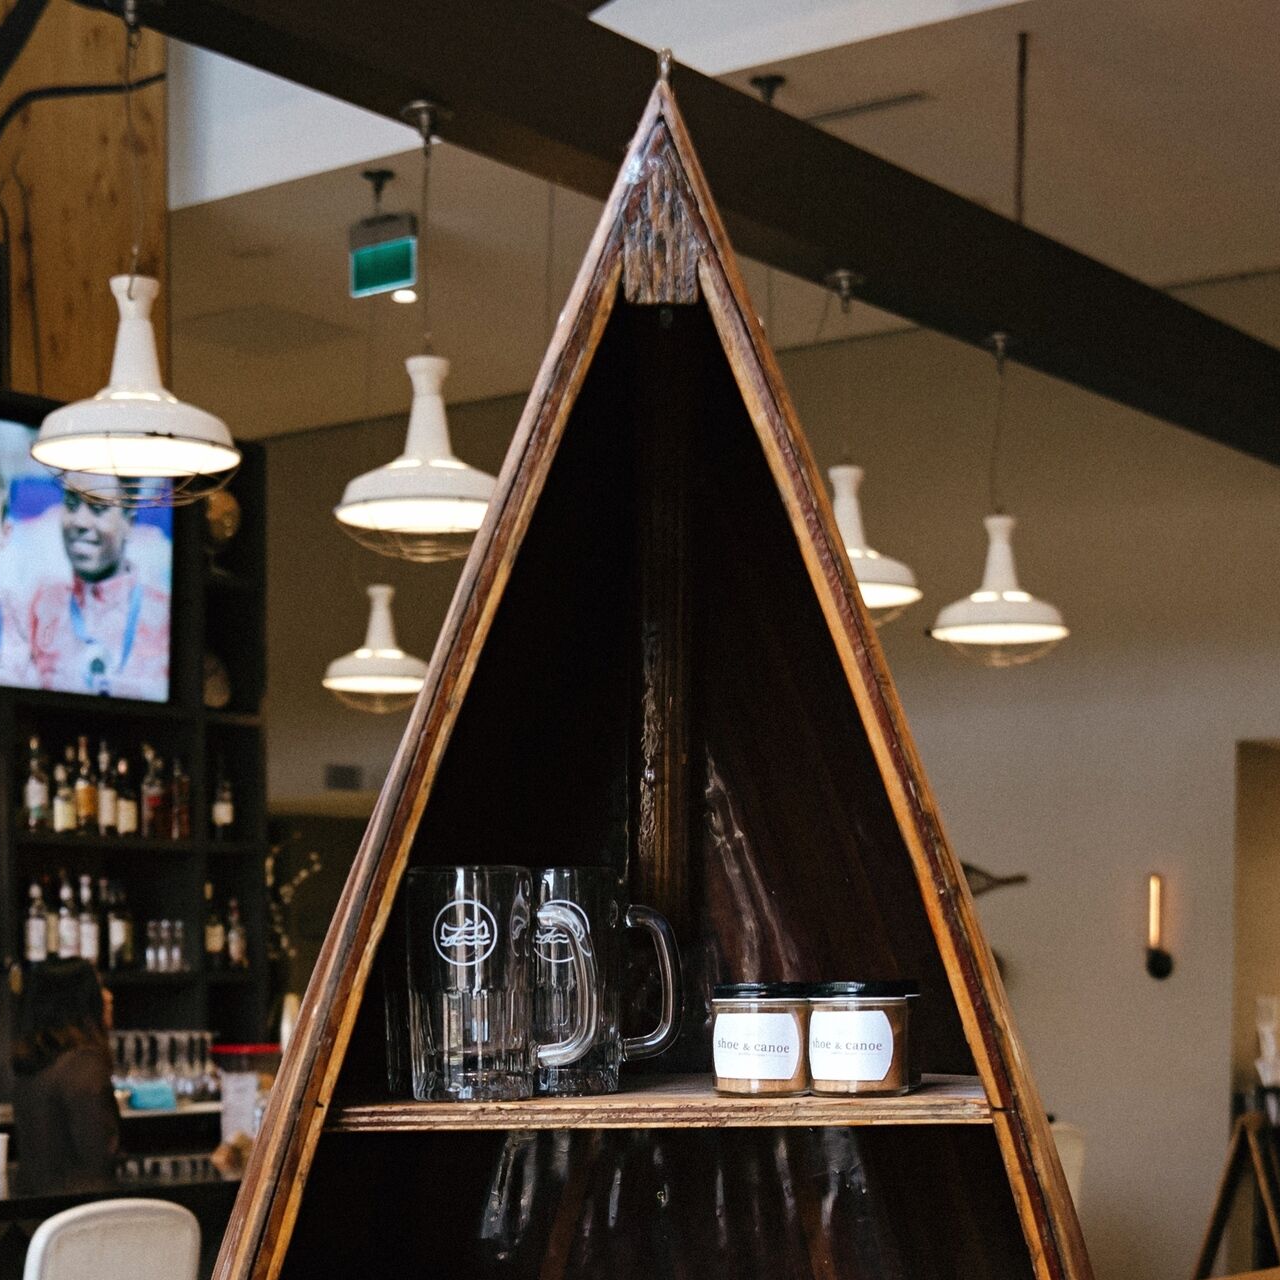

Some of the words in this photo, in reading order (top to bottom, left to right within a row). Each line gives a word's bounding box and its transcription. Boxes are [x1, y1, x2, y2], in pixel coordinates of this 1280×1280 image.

[717, 1037, 739, 1050] shoe
[742, 1042, 751, 1051] &
[754, 1042, 790, 1053] canoe
[835, 1042, 842, 1050] &
[845, 1041, 883, 1051] canoe
